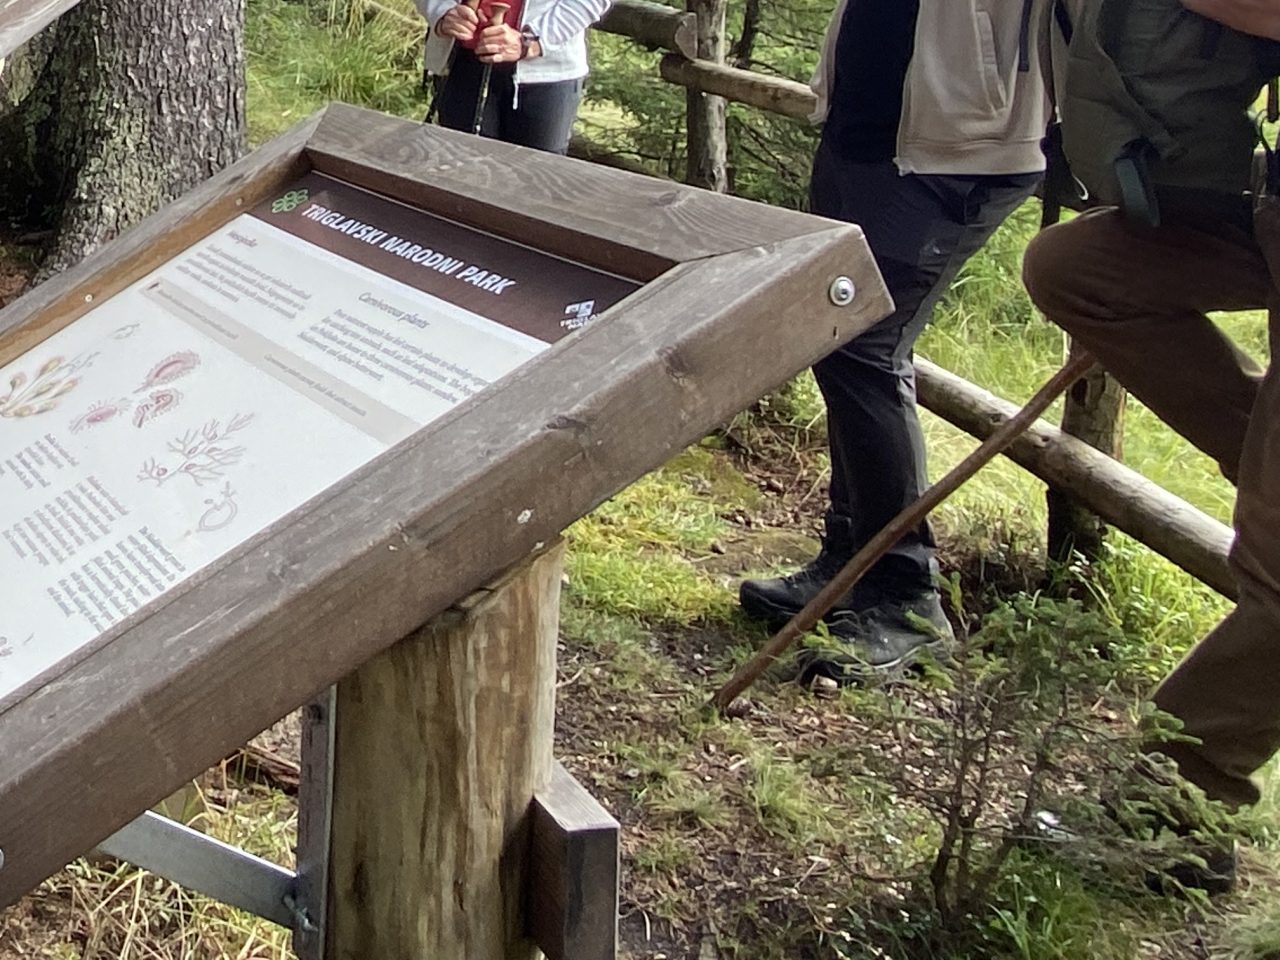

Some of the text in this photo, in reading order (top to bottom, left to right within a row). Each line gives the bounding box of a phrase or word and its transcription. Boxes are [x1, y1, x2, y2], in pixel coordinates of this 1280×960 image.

[301, 204, 388, 245] TRIGLAVSKI
[378, 236, 464, 275] NARODNI
[455, 265, 516, 295] PARK
[358, 292, 430, 329] Carnivorous plants
